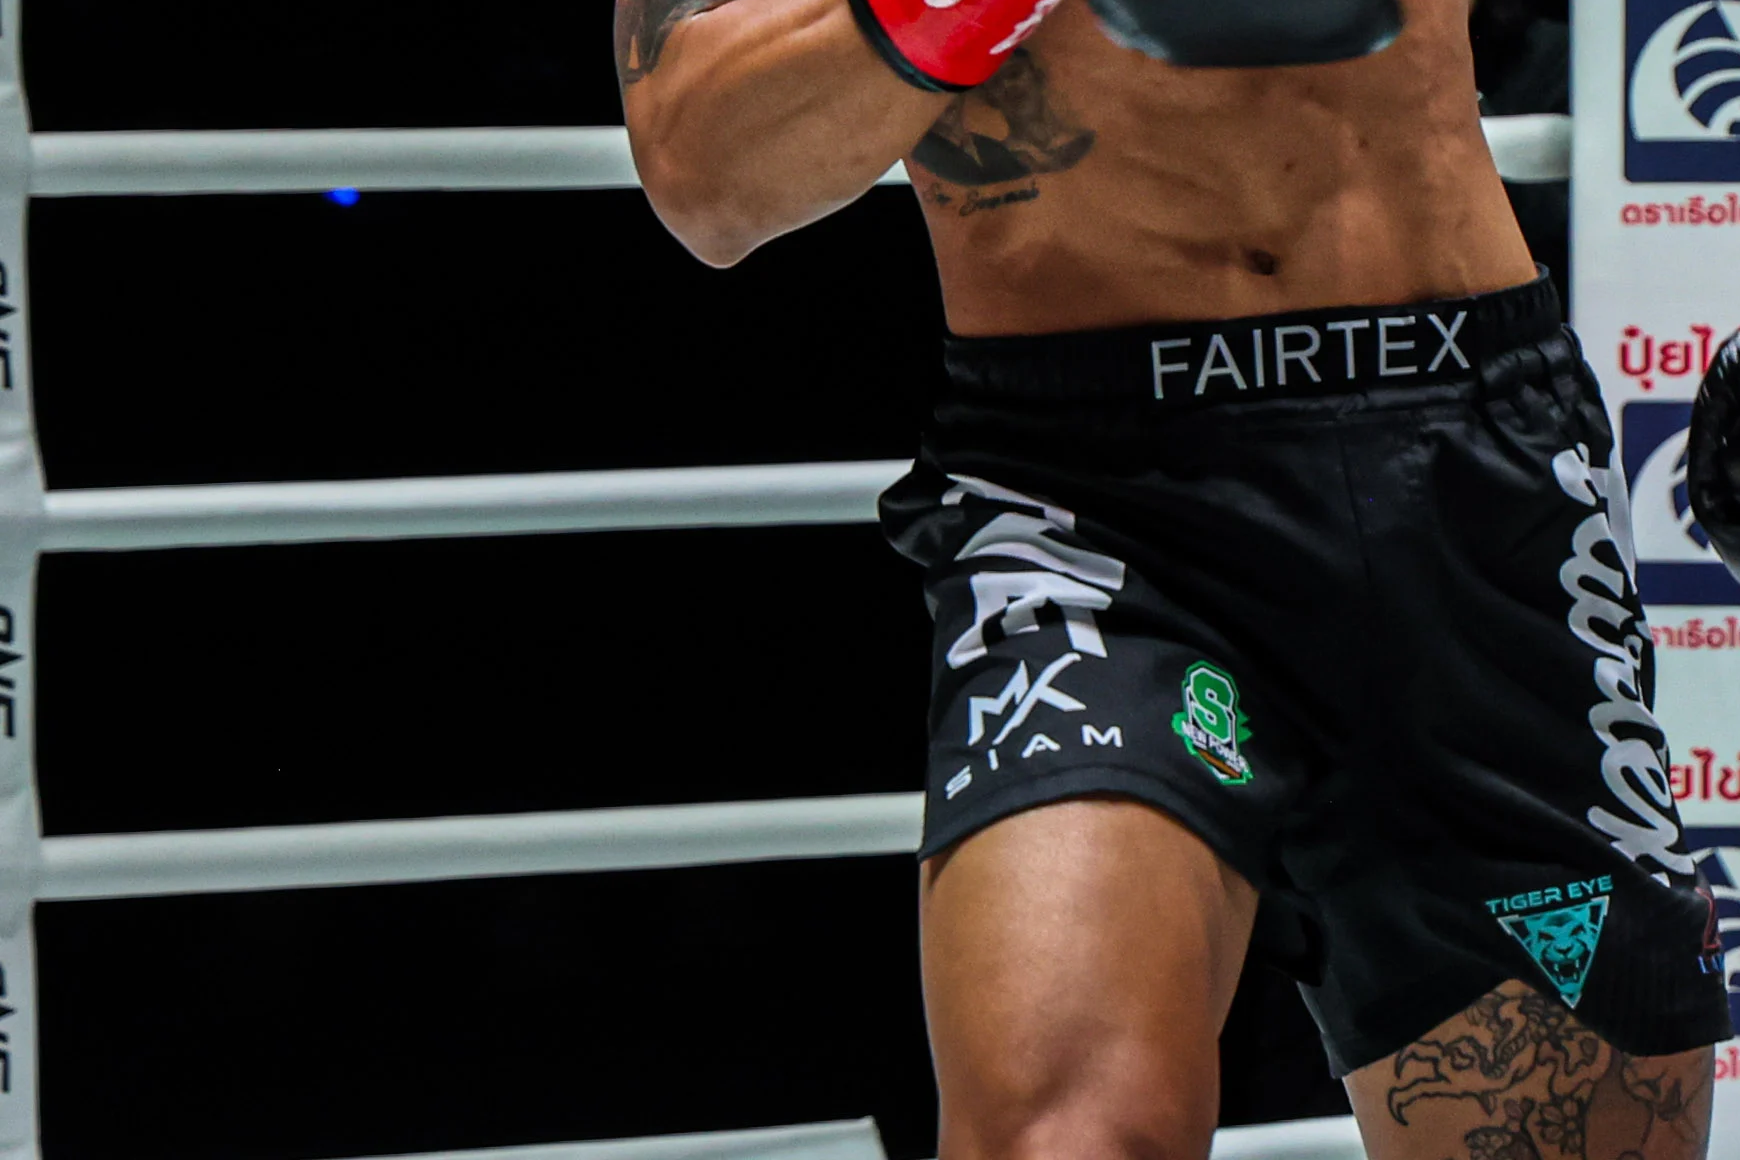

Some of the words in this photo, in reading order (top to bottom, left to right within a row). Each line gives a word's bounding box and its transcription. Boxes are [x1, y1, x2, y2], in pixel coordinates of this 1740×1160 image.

[1151, 310, 1470, 400] FAIRTEX
[1190, 667, 1234, 743] S
[945, 724, 1124, 800] SIAM
[1485, 887, 1563, 914] TIGER
[1566, 874, 1614, 899] EYE
